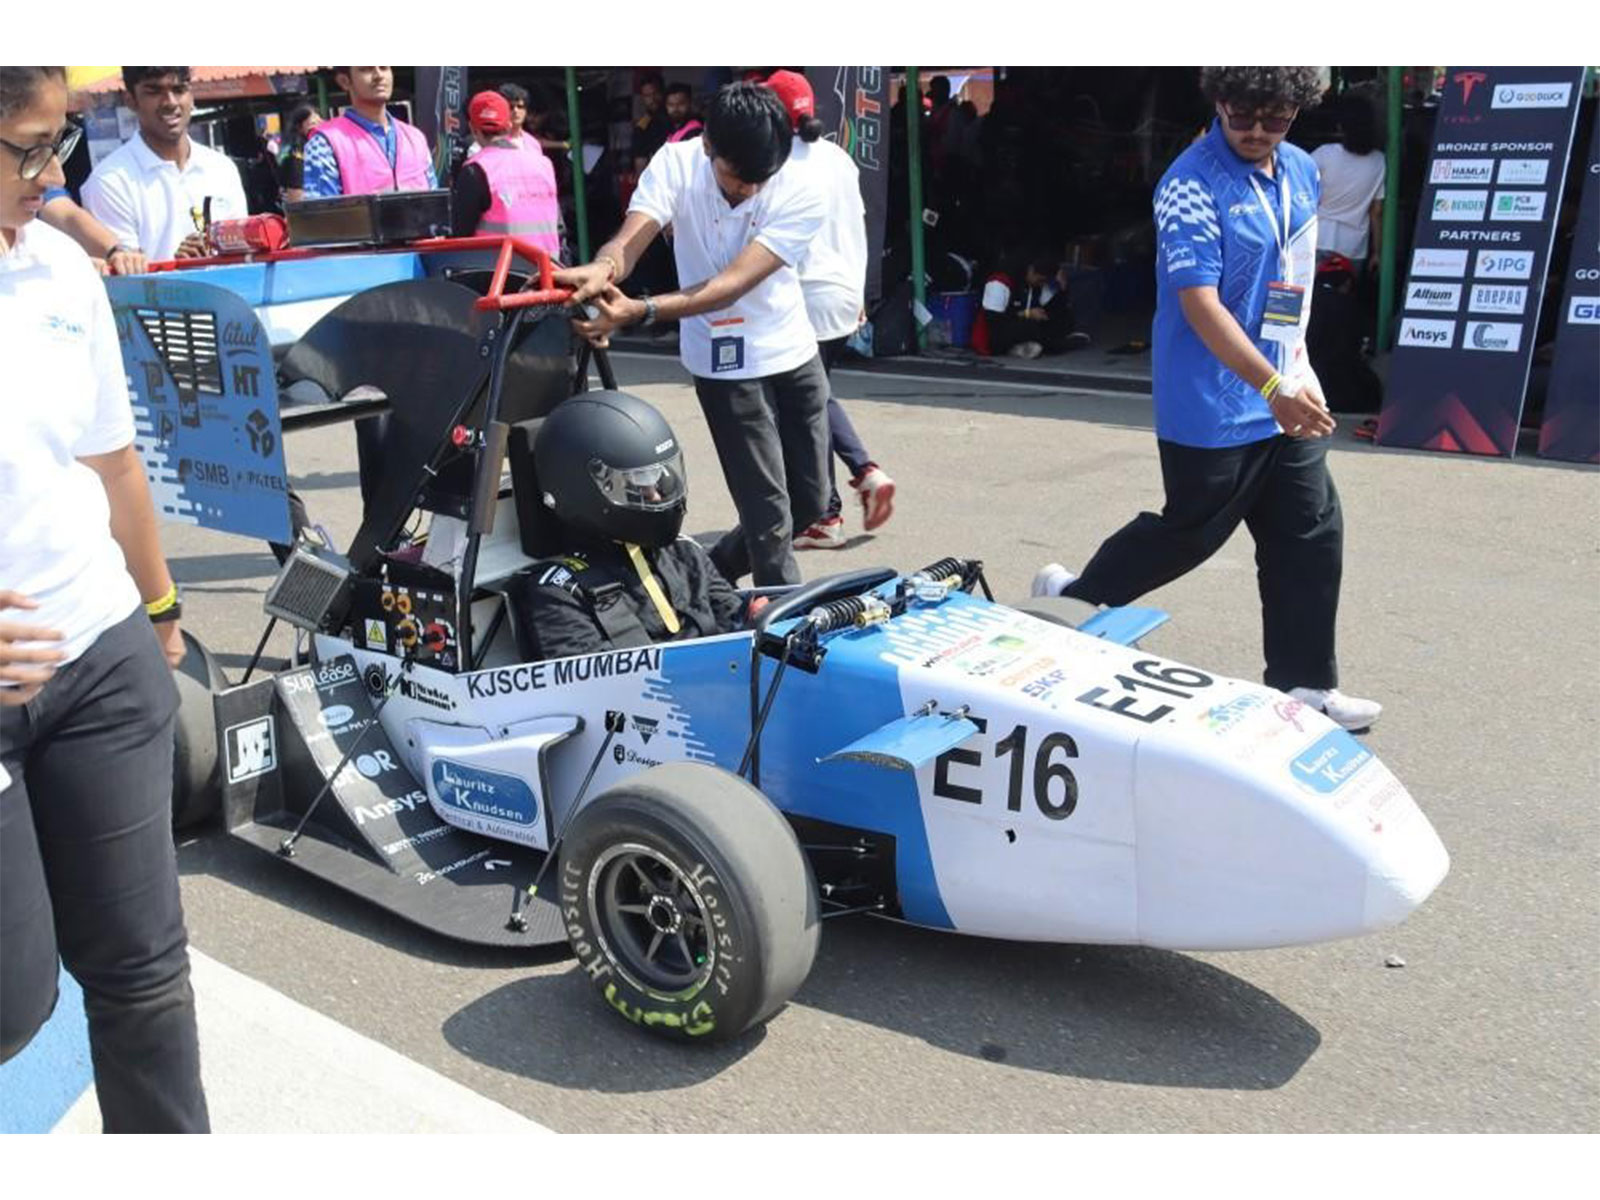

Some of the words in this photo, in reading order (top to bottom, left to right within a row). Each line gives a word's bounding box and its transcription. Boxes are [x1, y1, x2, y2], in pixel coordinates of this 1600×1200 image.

[1437, 142, 1488, 152] BRONZE
[1490, 142, 1553, 152] SPONSOR
[1439, 230, 1522, 242] PARTNERS
[1497, 258, 1526, 272] IPG
[1412, 287, 1453, 300] Altium
[1404, 327, 1448, 343] Ansys
[466, 664, 547, 699] KJSCE
[554, 648, 660, 685] MUMBAI
[1074, 660, 1214, 724] E16
[442, 764, 495, 793] Lauritz
[933, 711, 1079, 820] E16
[351, 790, 428, 825] Ansys
[455, 787, 523, 820] Knudsen
